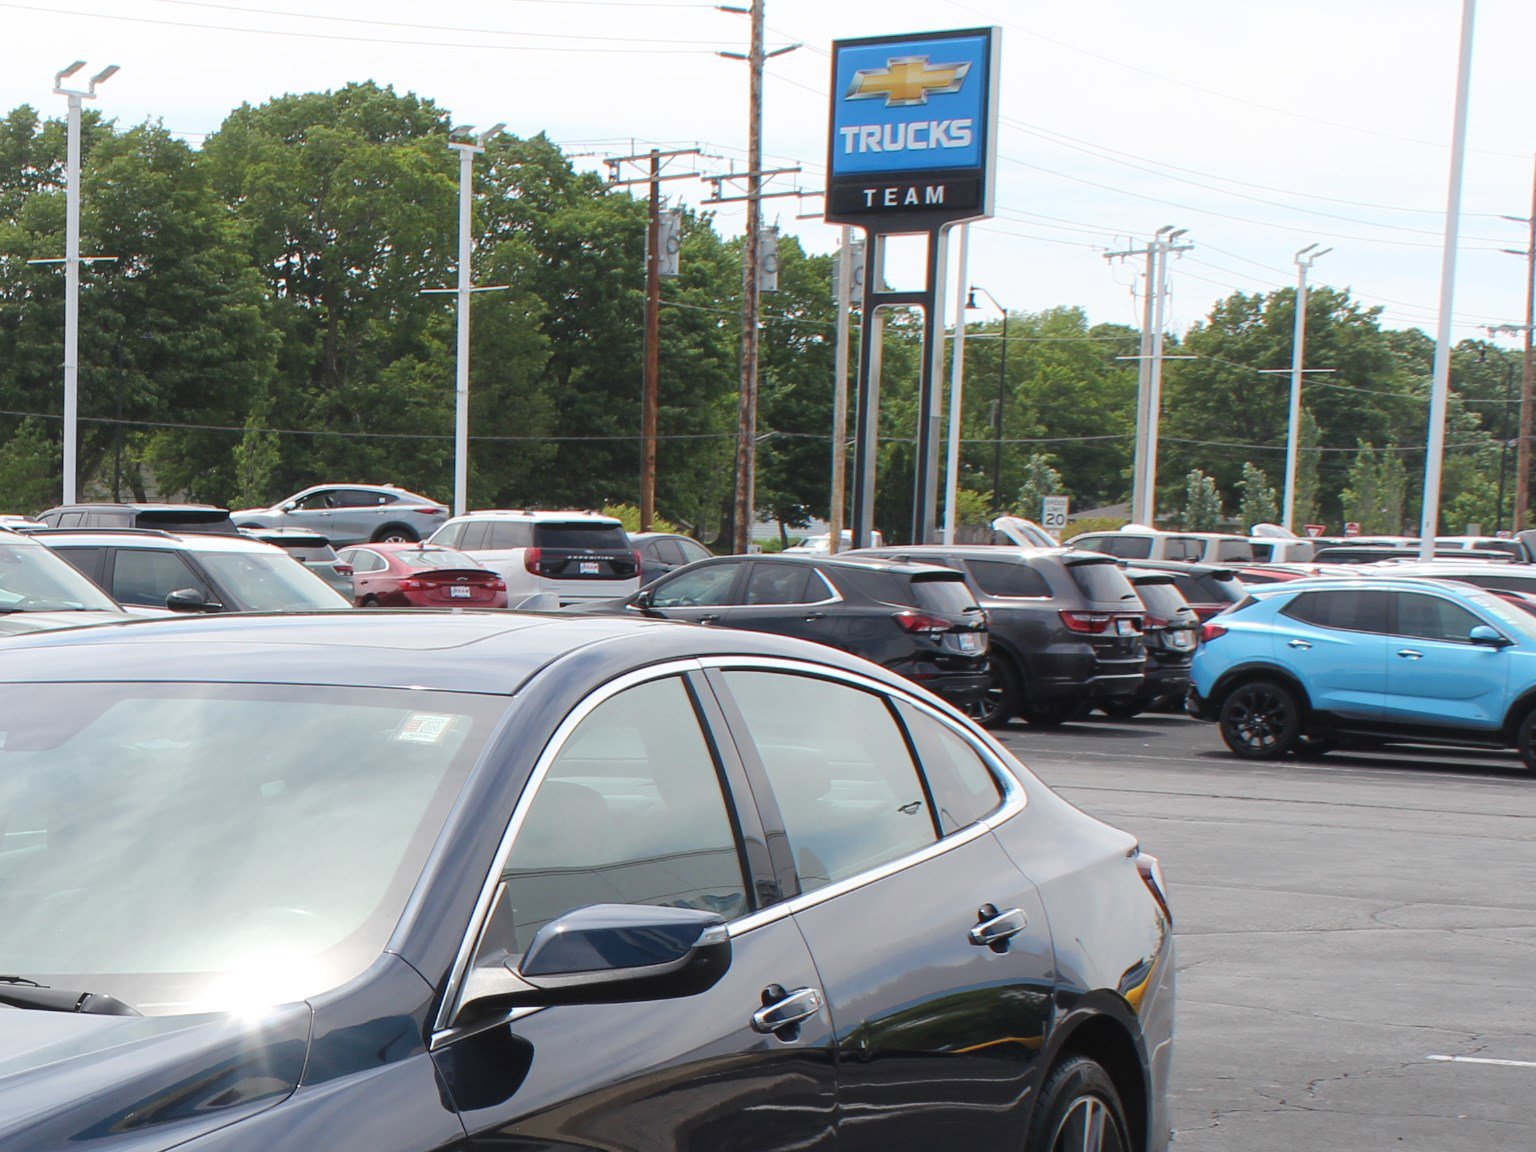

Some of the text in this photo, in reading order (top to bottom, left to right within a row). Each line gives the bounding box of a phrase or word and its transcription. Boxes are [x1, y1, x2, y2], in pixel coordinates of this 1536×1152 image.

[840, 118, 973, 154] TRUCKS
[863, 185, 945, 208] TEAM
[1046, 513, 1065, 526] 20
